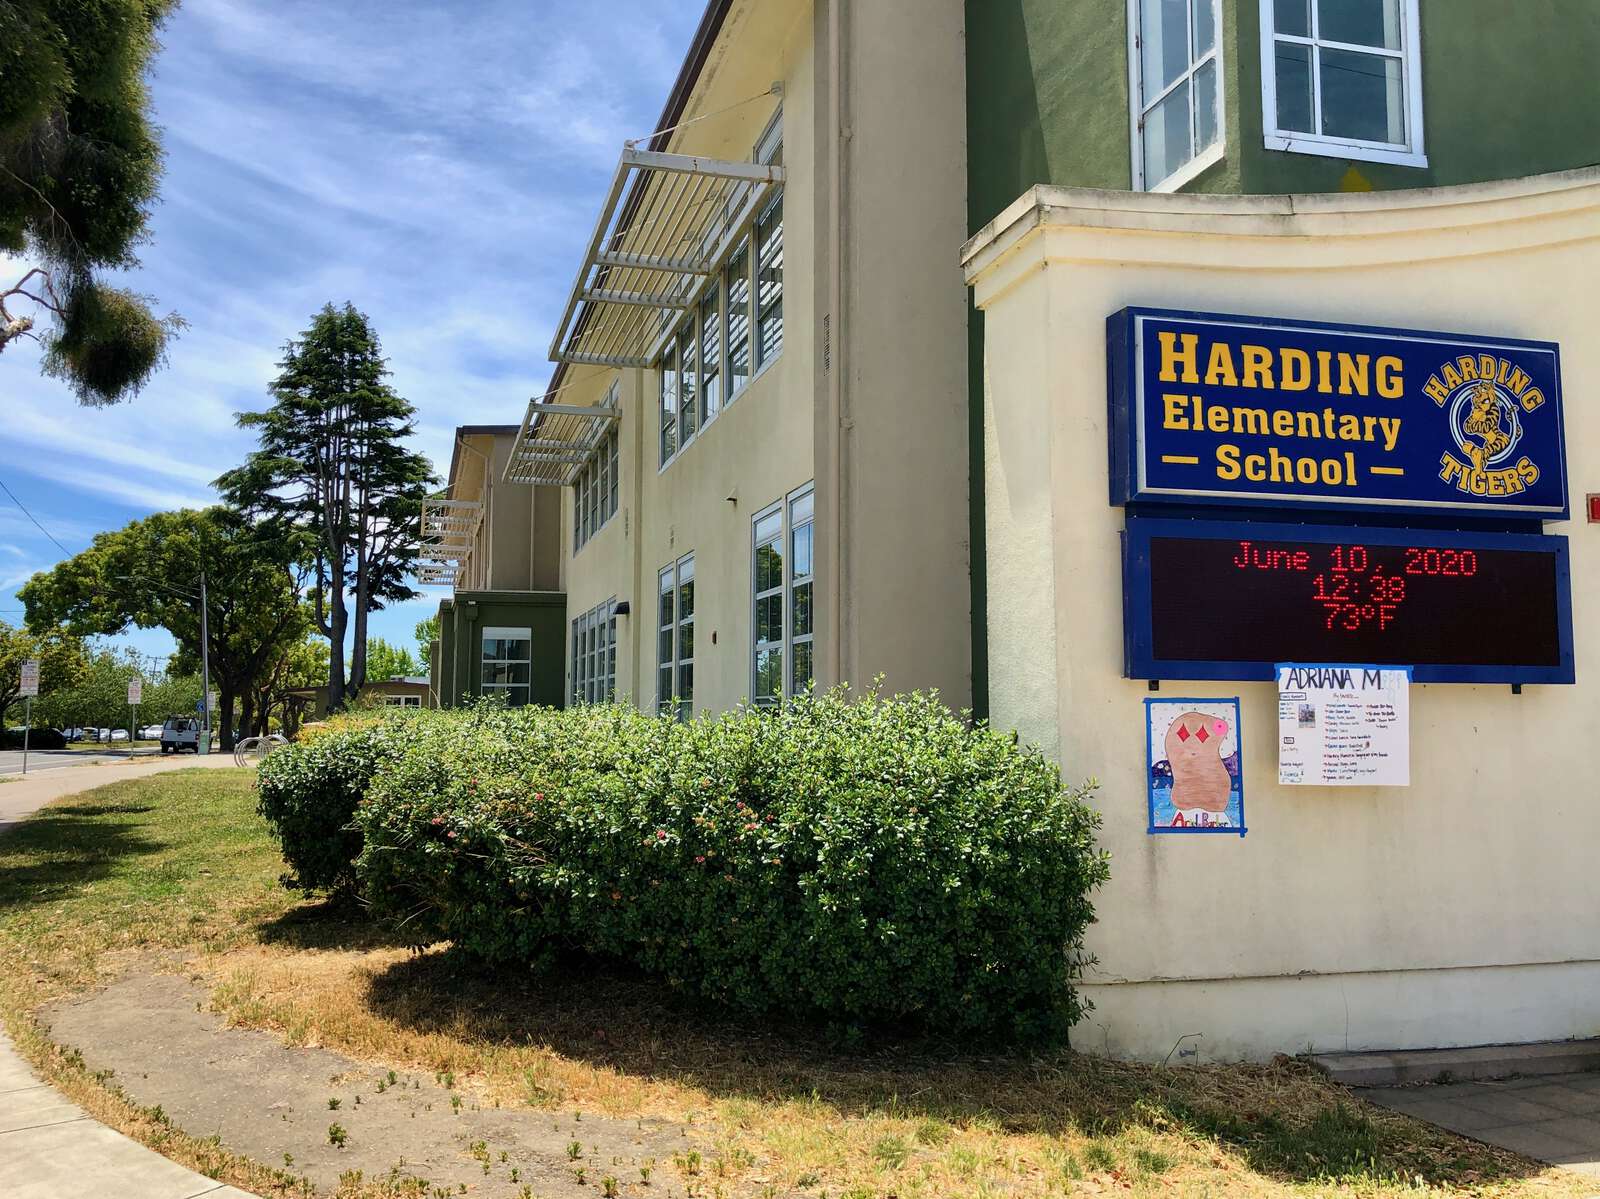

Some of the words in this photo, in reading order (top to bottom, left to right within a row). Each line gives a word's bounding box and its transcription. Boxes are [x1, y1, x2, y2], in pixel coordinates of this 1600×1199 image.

[1158, 331, 1404, 399] HARDING
[1422, 353, 1545, 413] HARDING
[1162, 394, 1401, 451] Elementary
[1216, 444, 1357, 486] School
[1438, 450, 1540, 497] TIGERS
[1233, 541, 1311, 572] June
[1329, 545, 1382, 575] 10,
[1404, 548, 1478, 578] 2020
[1311, 574, 1406, 602] 12:38
[1285, 667, 1355, 690] ADRIANA
